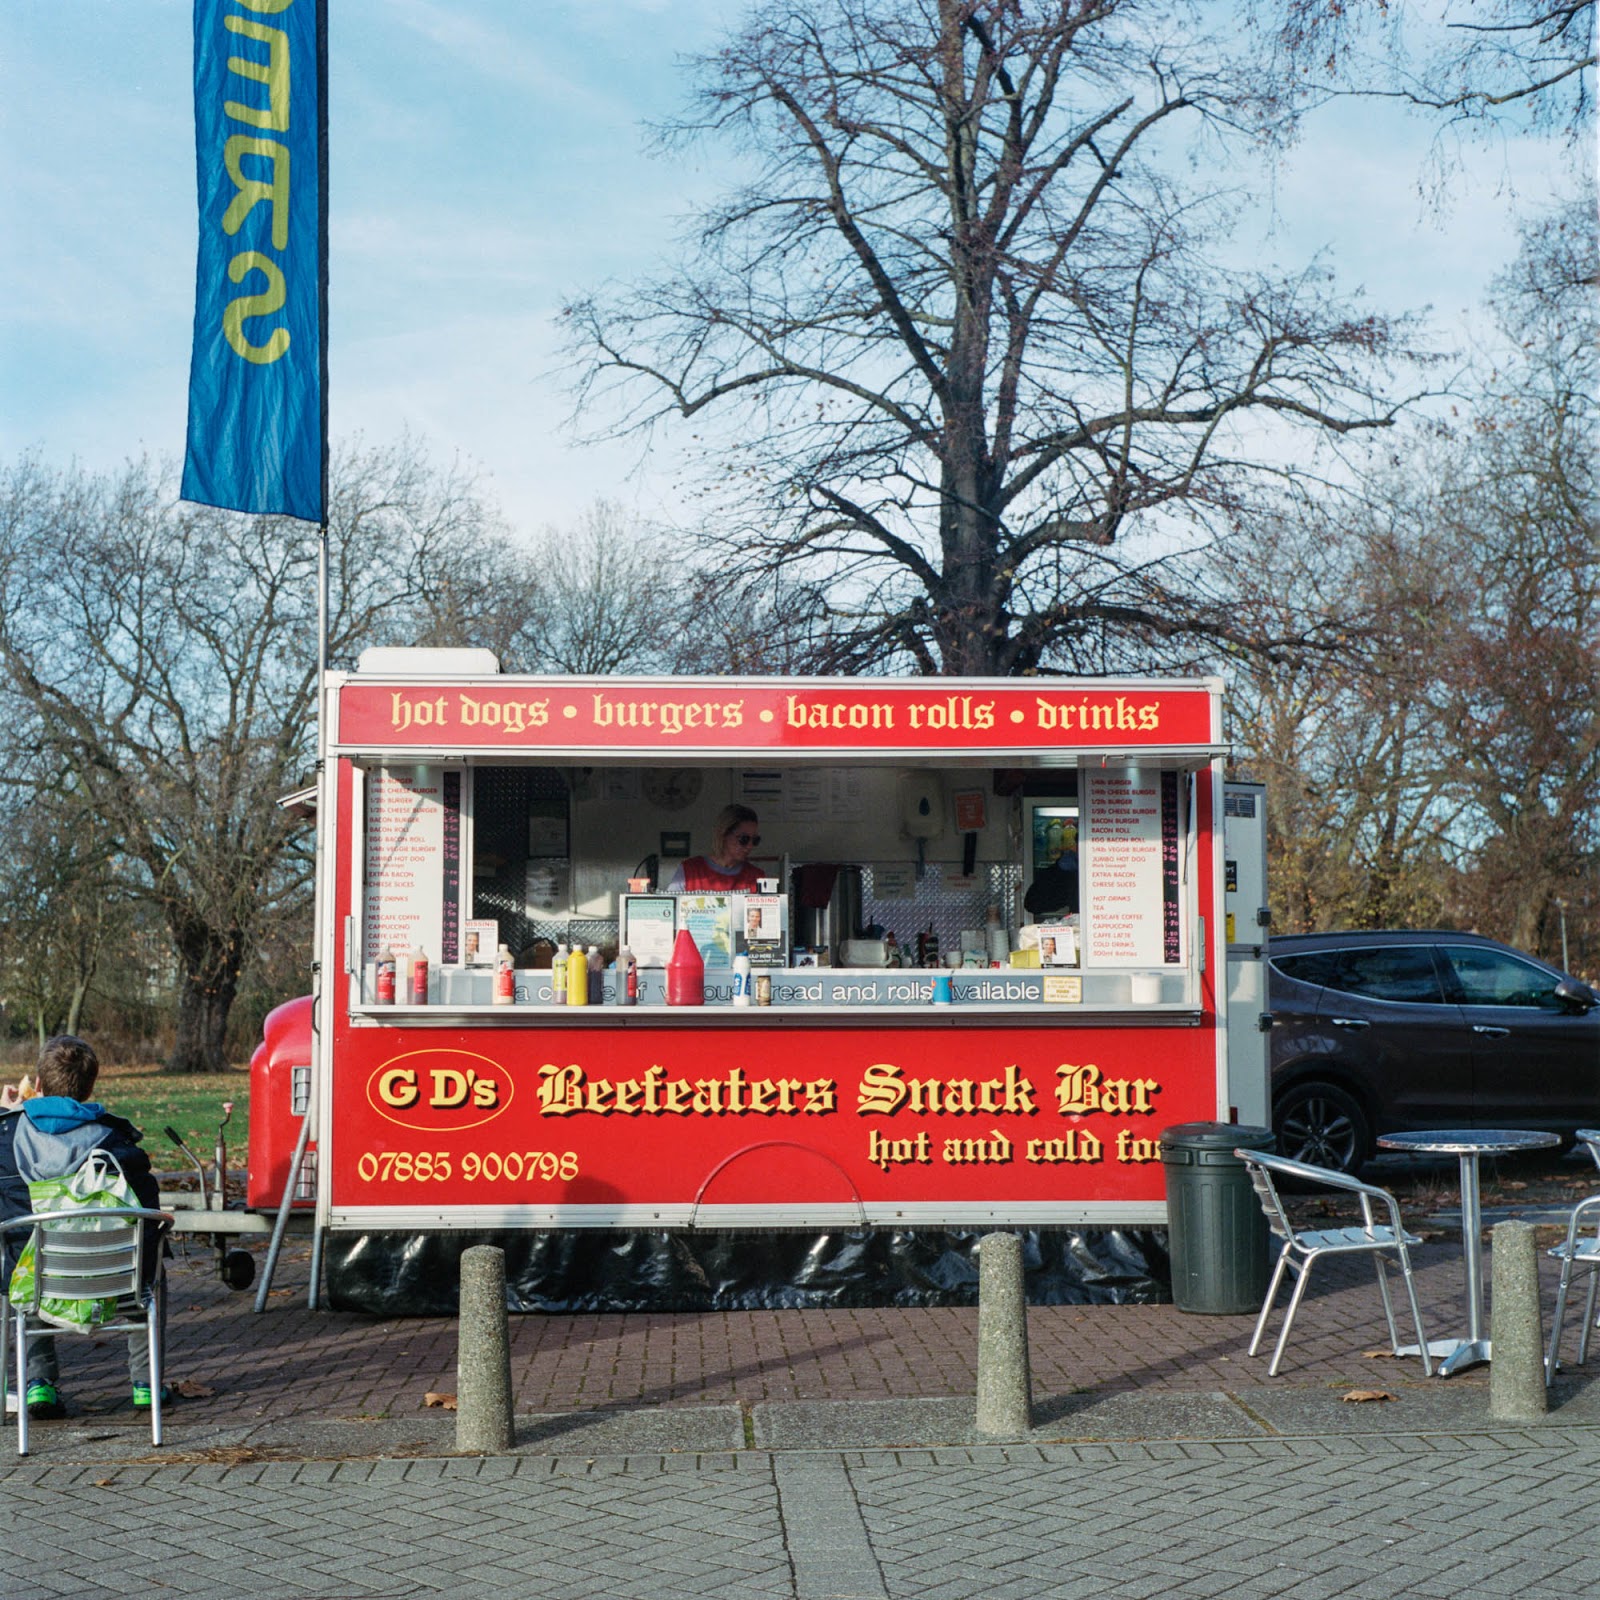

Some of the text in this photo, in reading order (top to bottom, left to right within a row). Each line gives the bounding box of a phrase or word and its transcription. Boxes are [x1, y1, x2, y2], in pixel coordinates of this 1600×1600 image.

[391, 693, 1160, 734] hot dogs burgers bacon rolls drinks
[515, 985, 529, 1001] a
[832, 982, 877, 1000] and
[887, 982, 933, 1000] rolls
[951, 981, 1041, 1000] vailable
[378, 1069, 498, 1108] G D's
[537, 1063, 1163, 1117] Beefeaters Snack Bar
[358, 1151, 579, 1182] 07885 900798
[868, 1129, 1161, 1173] hot and cold fo
